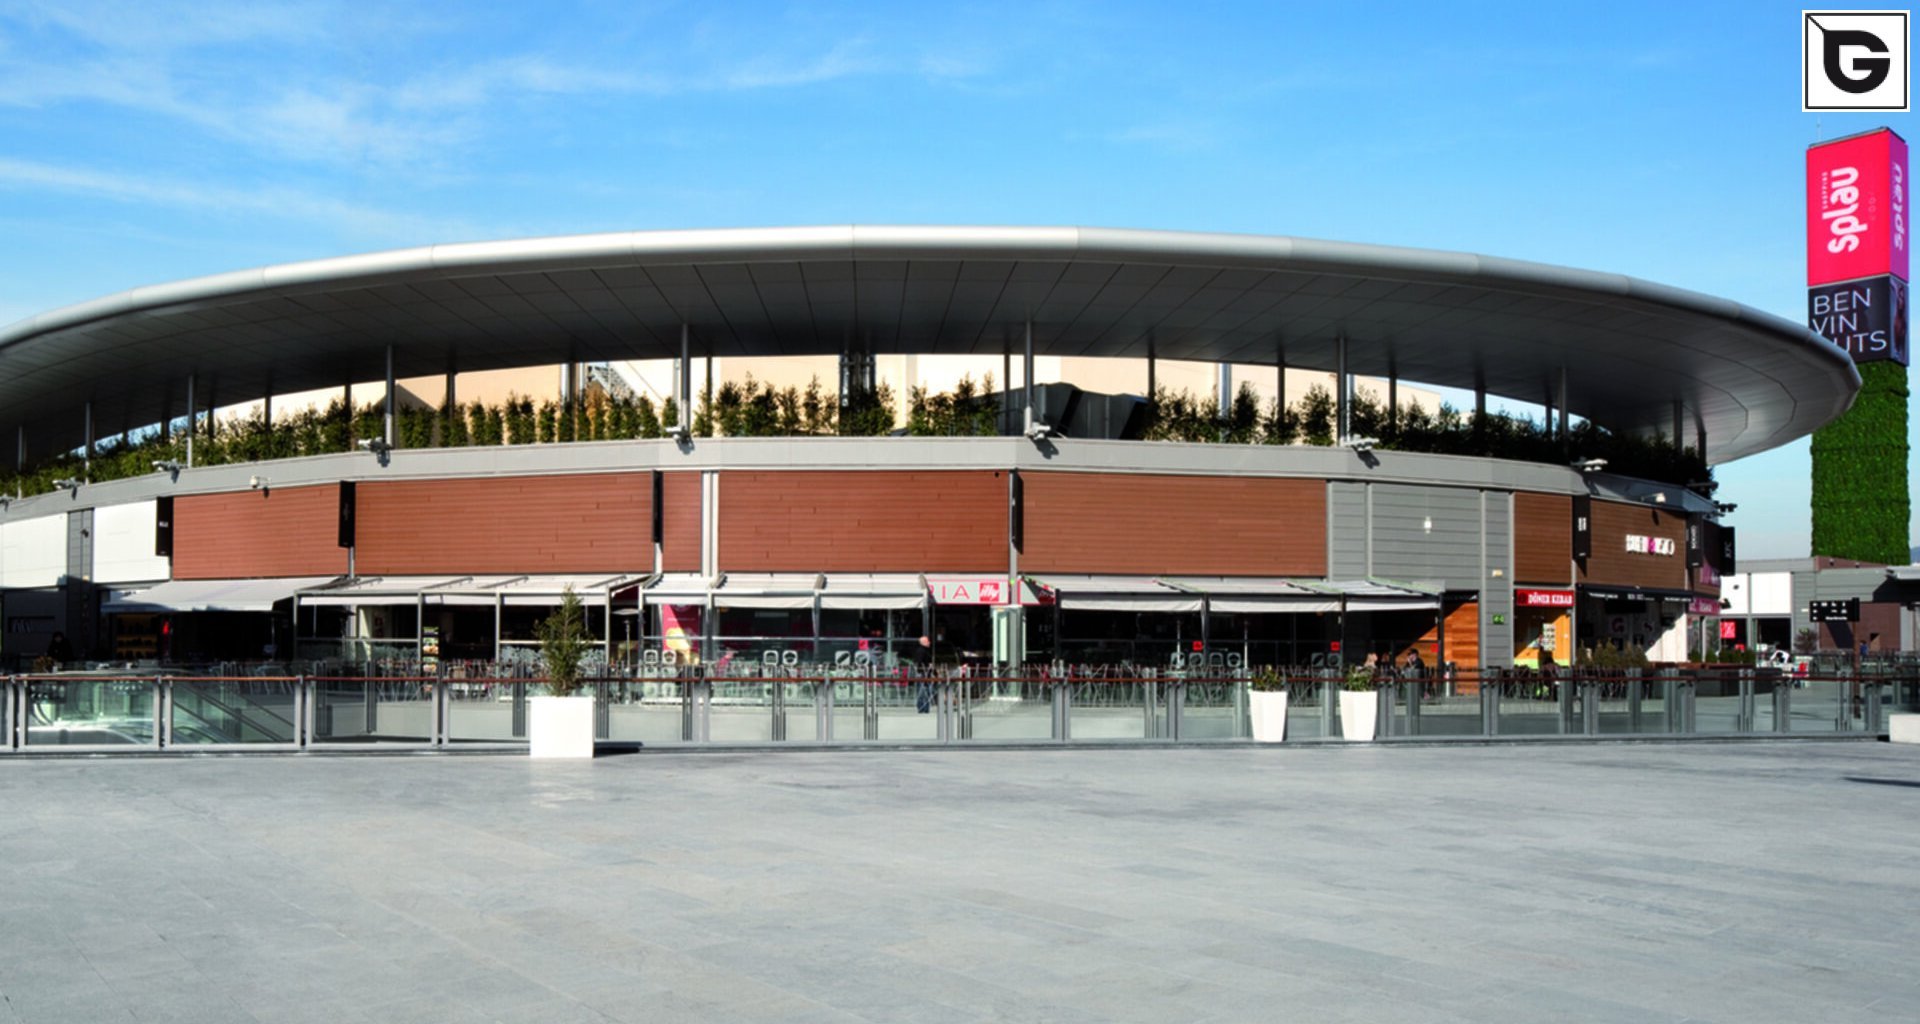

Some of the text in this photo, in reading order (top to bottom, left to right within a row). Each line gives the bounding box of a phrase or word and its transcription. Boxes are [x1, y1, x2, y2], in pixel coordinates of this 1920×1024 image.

[1822, 166, 1868, 254] splau
[1893, 161, 1905, 251] splau
[1814, 288, 1871, 315] BEN
[1812, 312, 1857, 336] VIN
[980, 584, 999, 601] illy
